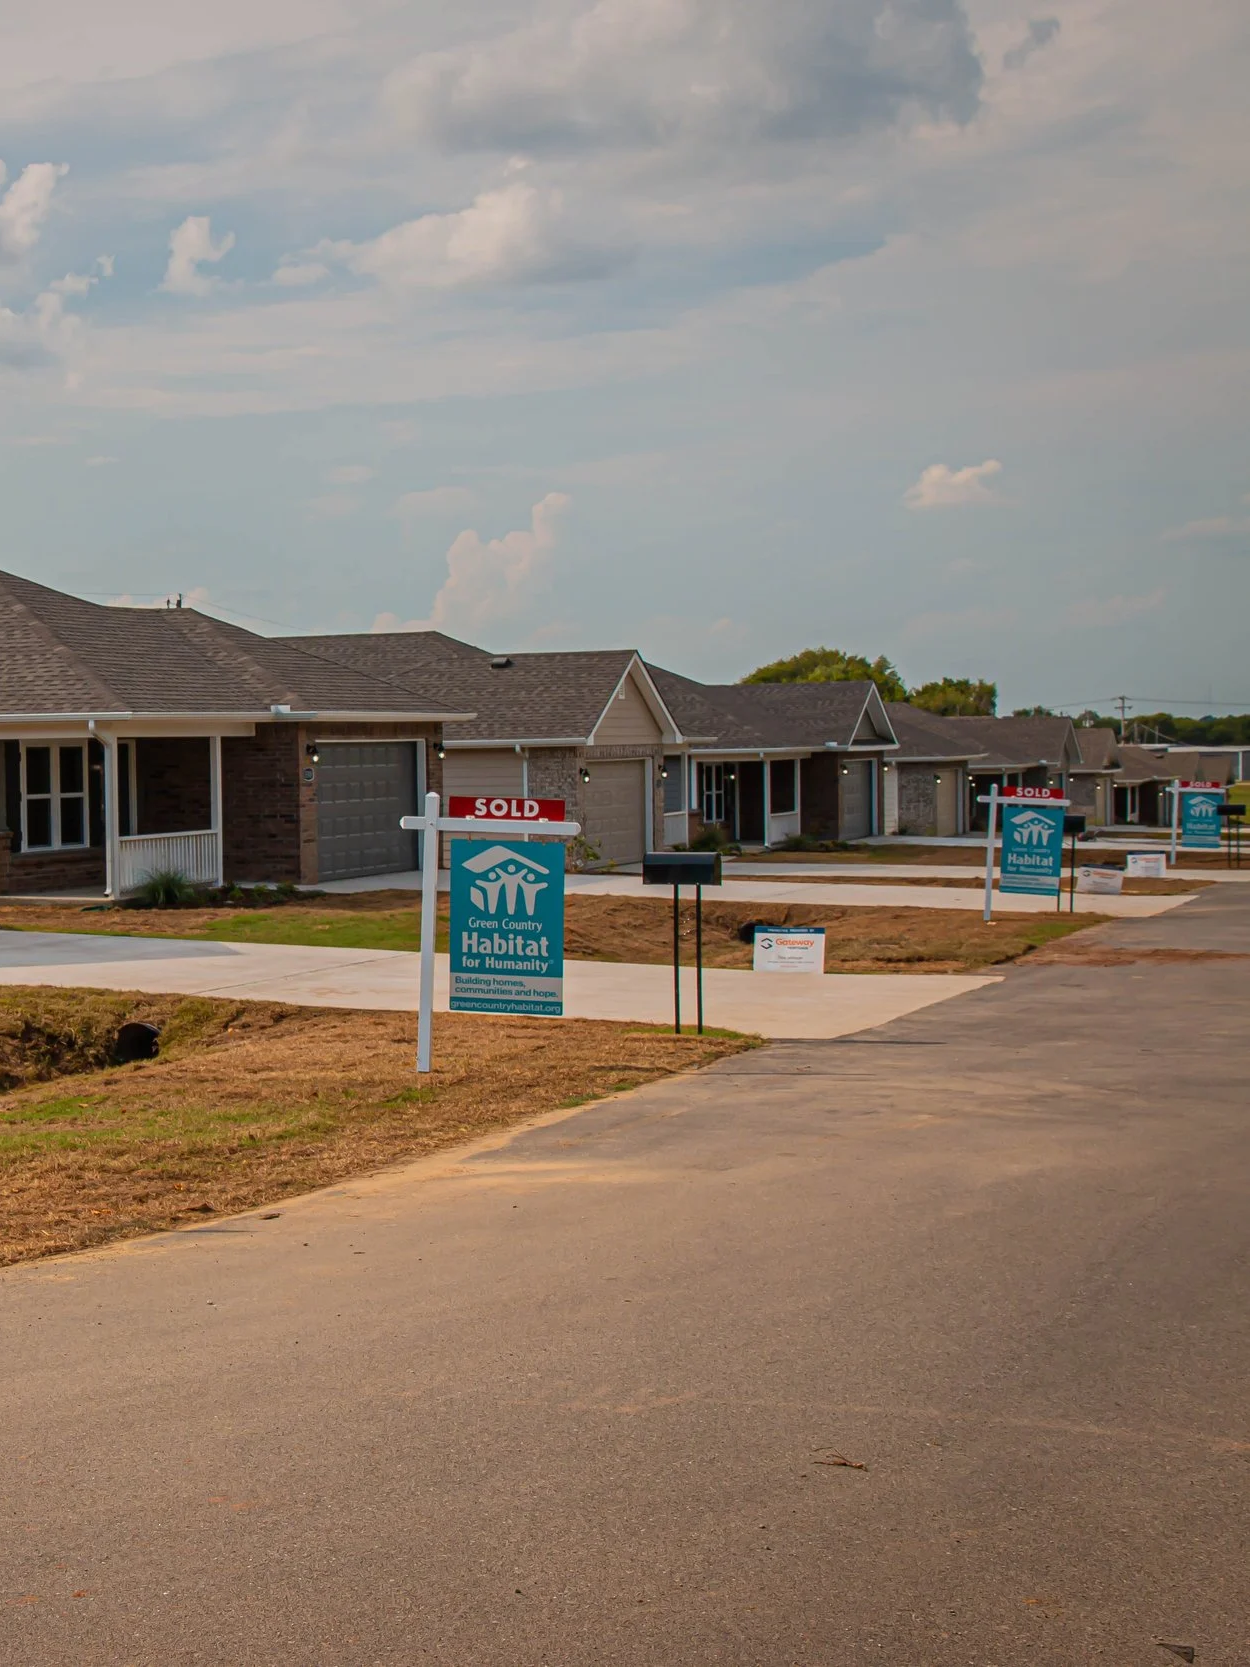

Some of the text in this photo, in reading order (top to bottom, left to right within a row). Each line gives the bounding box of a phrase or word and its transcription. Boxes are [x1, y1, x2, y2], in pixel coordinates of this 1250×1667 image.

[1016, 788, 1050, 798] SOLD
[475, 798, 540, 818] SOLD
[1008, 853, 1053, 866] Habitat
[468, 917, 542, 932] Green Country
[462, 932, 549, 957] Habitat
[776, 938, 814, 946] Gateway
[462, 956, 548, 974] for Humanity
[455, 976, 526, 988] Building homes,
[455, 987, 558, 998] communities and hope.
[451, 1001, 561, 1014] greencountryhabitat.org
